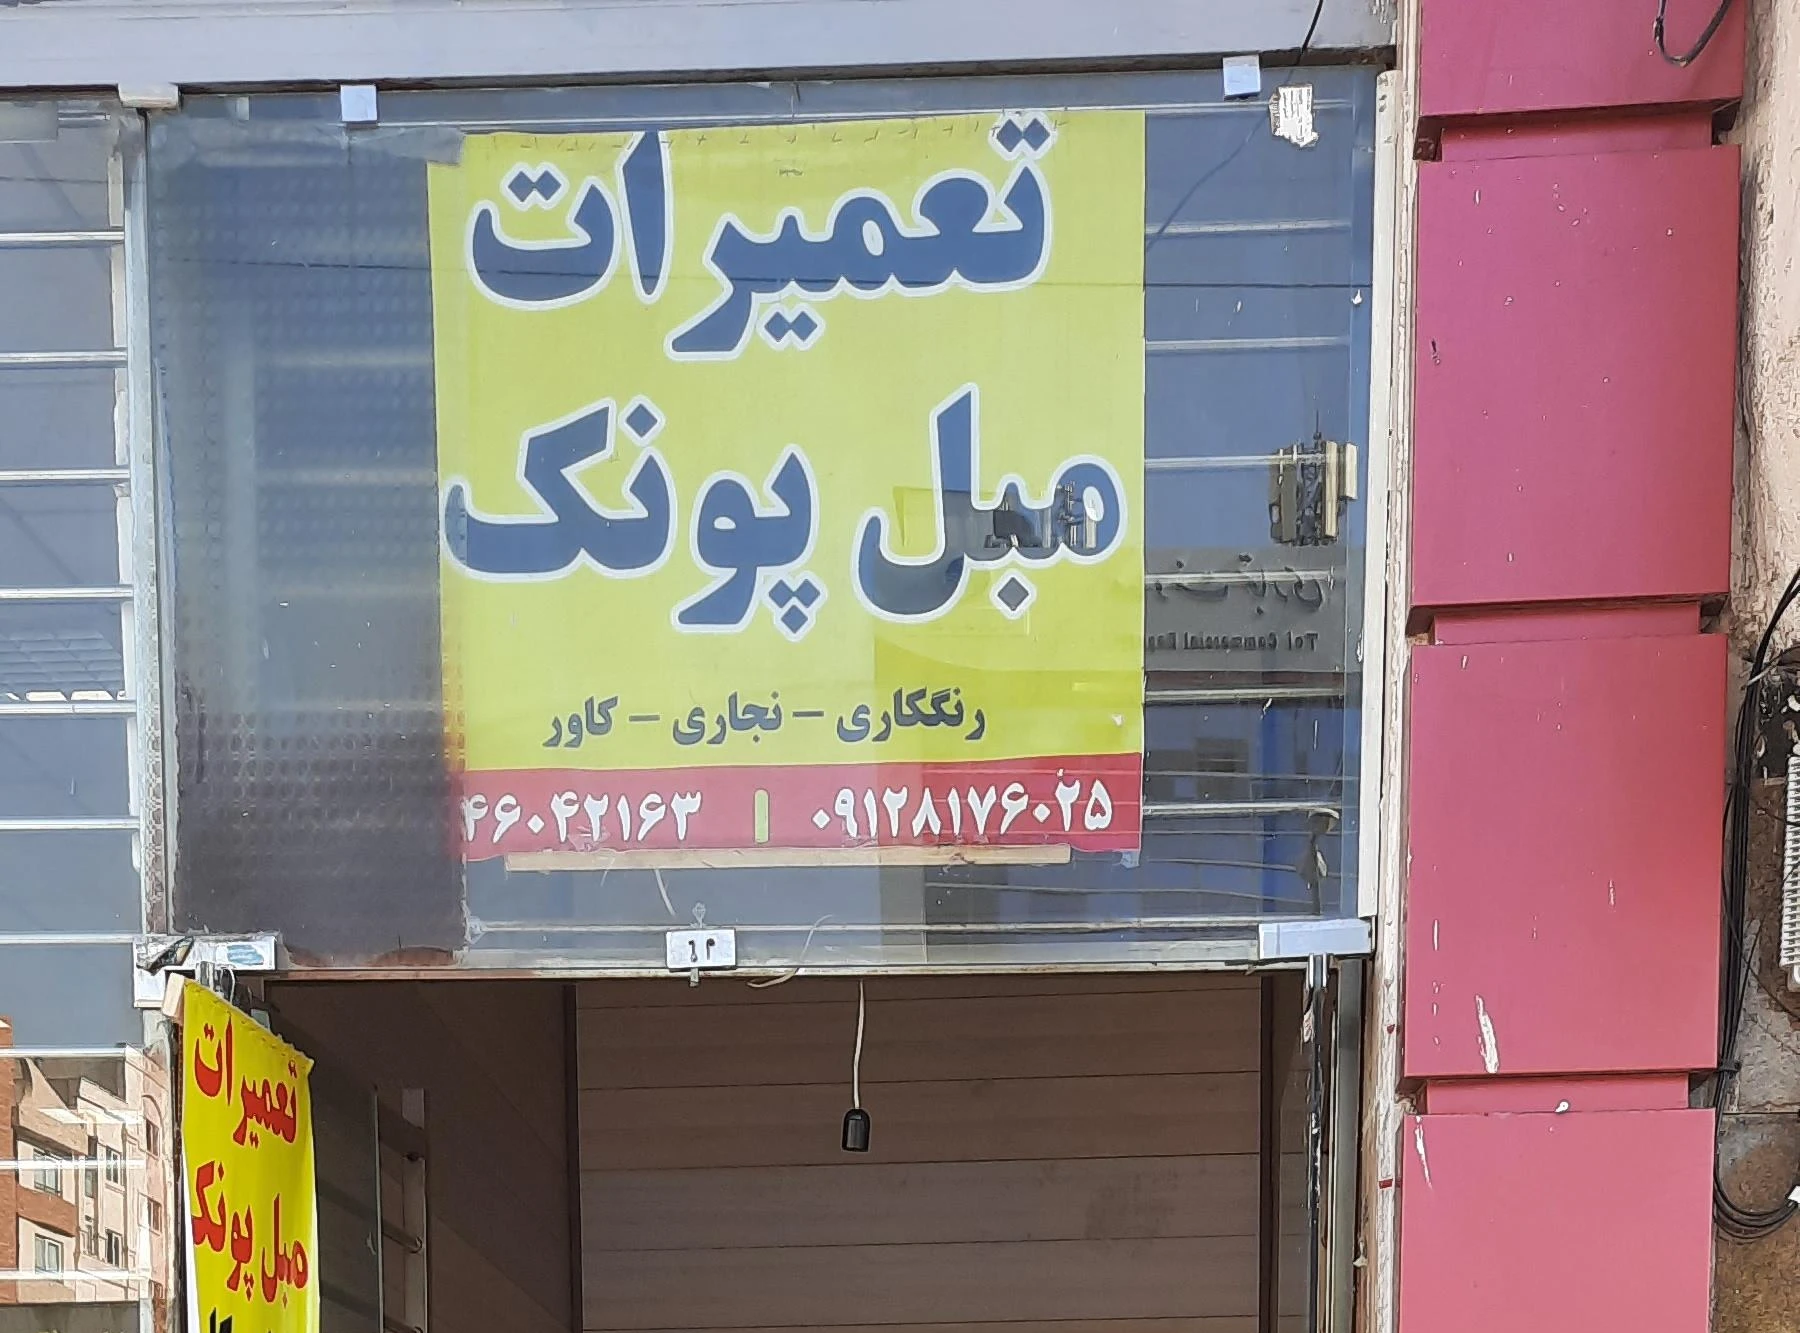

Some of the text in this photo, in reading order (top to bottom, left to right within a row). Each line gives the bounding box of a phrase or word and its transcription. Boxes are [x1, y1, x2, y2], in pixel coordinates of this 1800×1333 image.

[466, 110, 1055, 360] تعمیرات
[440, 383, 1127, 640] مبل پونک
[542, 696, 619, 749] کاور
[672, 691, 783, 745] نجاری
[836, 686, 986, 744] رنگکاری
[464, 779, 1114, 843] ۰۹۱۲۸۱۷۶۰۲۵ ۴۶۰۴۲۱۶۳
[194, 1014, 298, 1150] تعمیرات
[192, 1159, 309, 1308] مبل پونک
